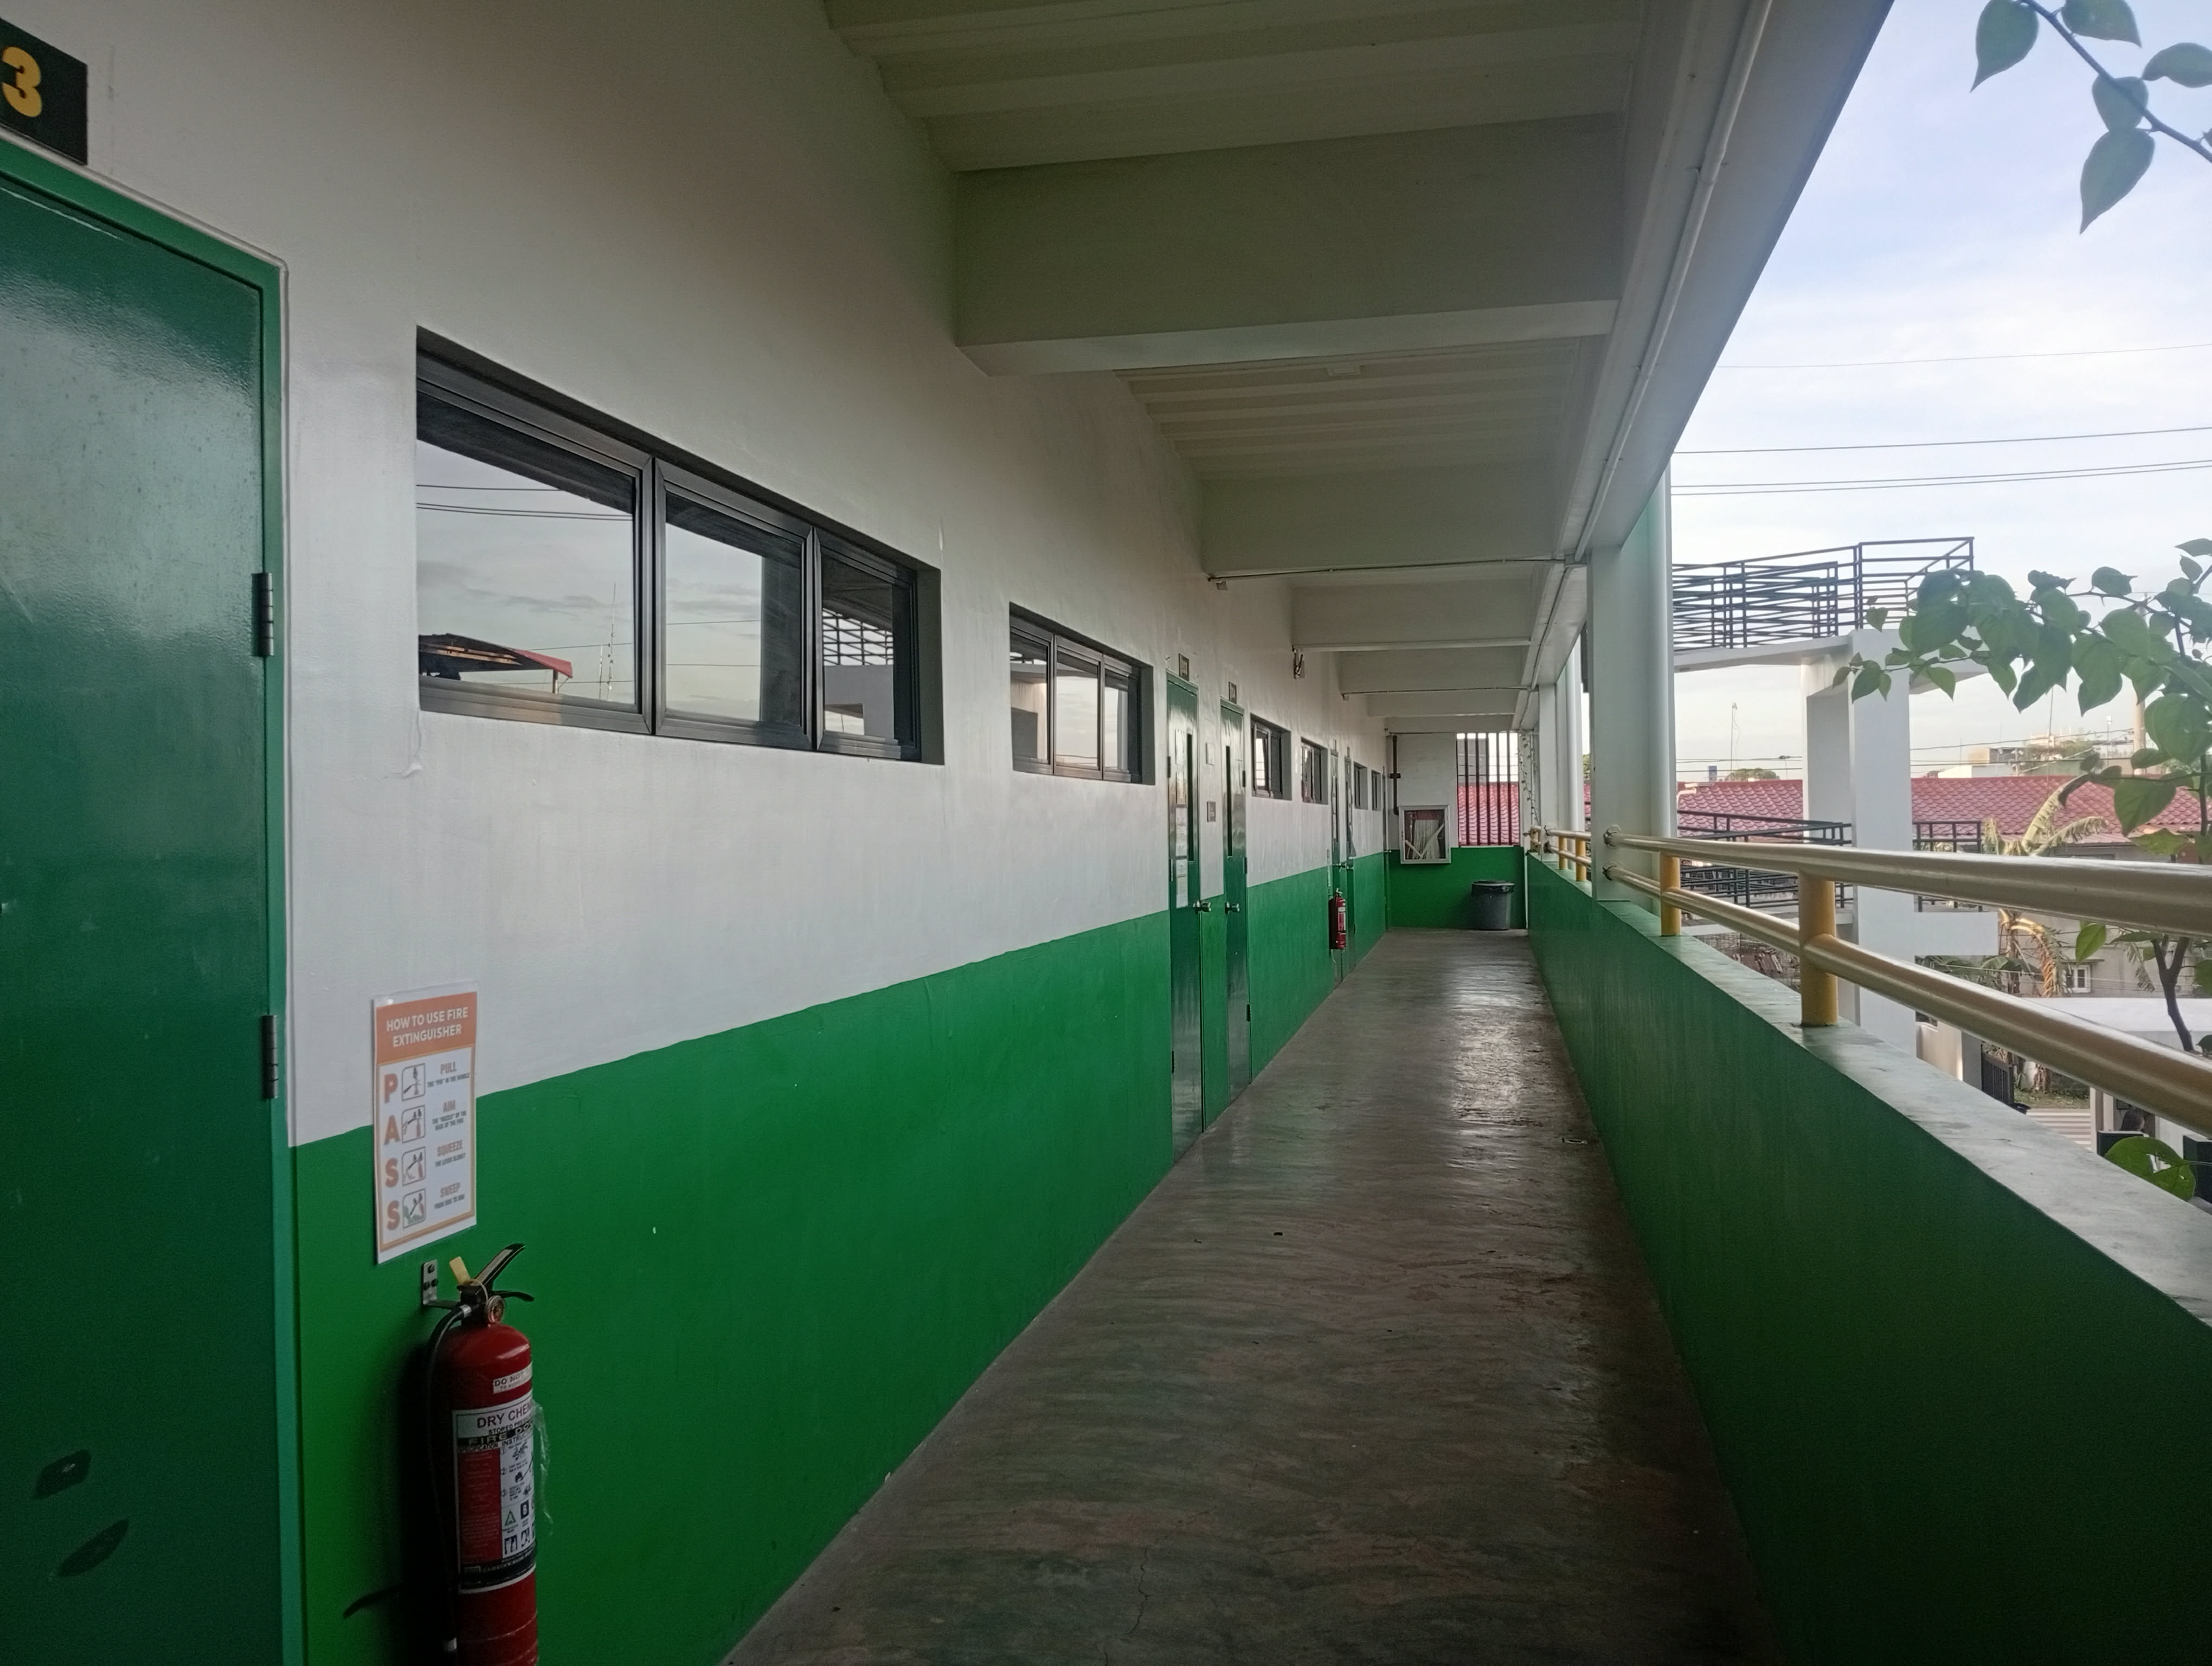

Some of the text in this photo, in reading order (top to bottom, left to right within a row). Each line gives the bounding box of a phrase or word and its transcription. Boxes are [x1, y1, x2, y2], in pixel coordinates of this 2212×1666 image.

[2, 46, 42, 117] 3
[387, 1007, 468, 1031] HOW TO USE FIRE
[393, 1024, 461, 1047] EXTINGUISHER
[440, 1061, 457, 1074] PULL
[384, 1073, 398, 1104] P
[383, 1114, 401, 1145] A
[437, 1140, 463, 1157] SQUEEZE
[385, 1157, 399, 1188] S
[387, 1200, 400, 1231] S
[494, 1378, 507, 1387] DO
[477, 1413, 505, 1428] DRY
[488, 1424, 513, 1436] STORED
[468, 1432, 508, 1445] FIRE
